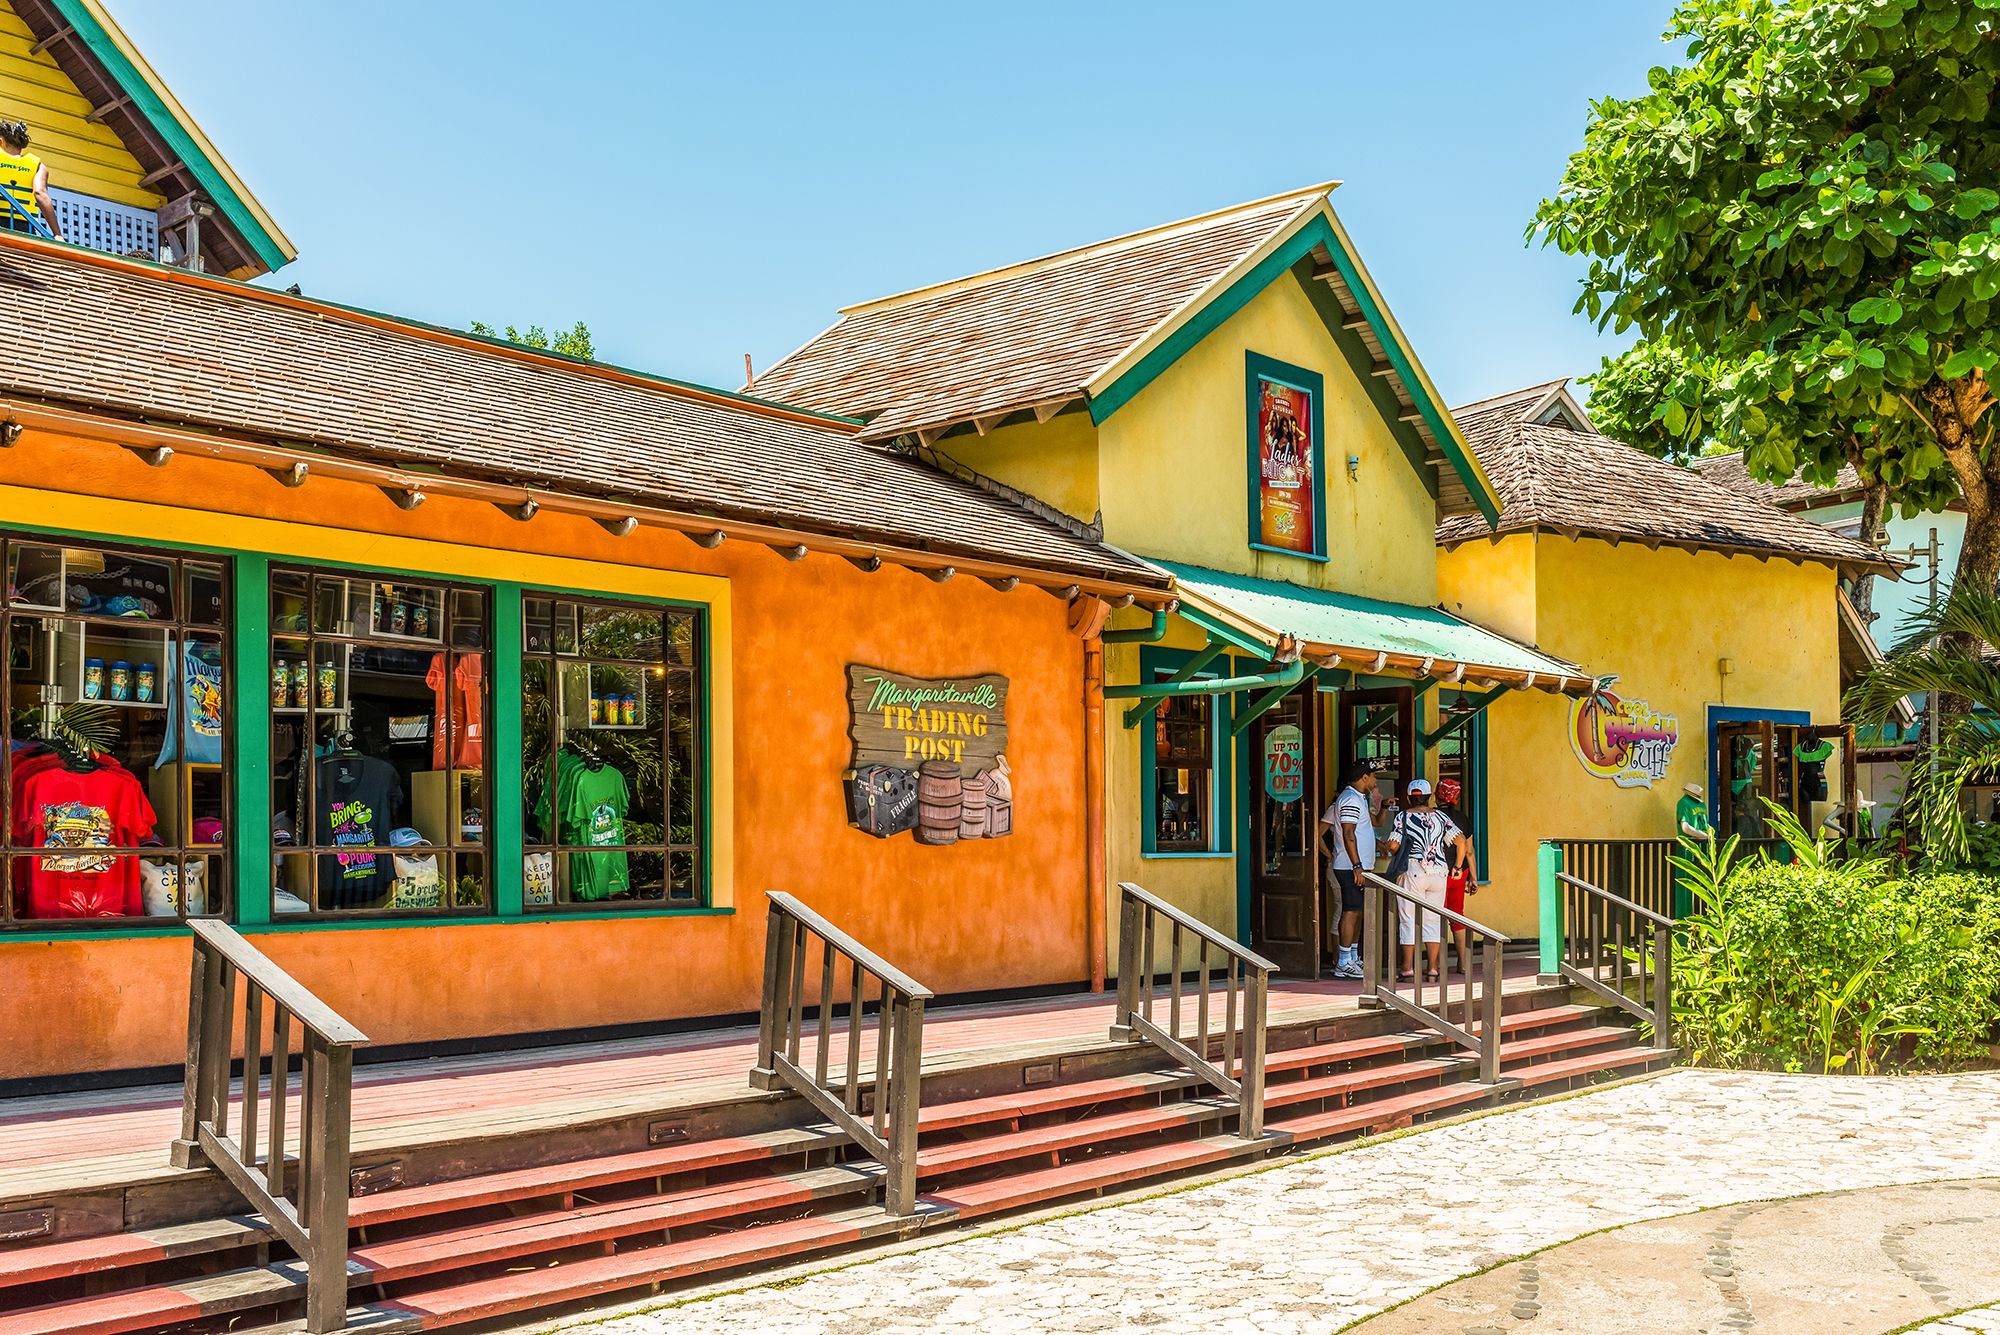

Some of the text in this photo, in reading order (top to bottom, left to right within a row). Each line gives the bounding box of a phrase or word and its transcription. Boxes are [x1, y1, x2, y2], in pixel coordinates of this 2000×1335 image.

[1270, 438, 1302, 467] Ladies
[864, 677, 997, 712] Margaritaville
[1616, 701, 1649, 717] COOL
[880, 705, 988, 737] TRADING
[1604, 715, 1677, 748] BEACH
[904, 735, 965, 763] POST
[1273, 742, 1300, 752] UP TO
[1267, 753, 1303, 774] 70%
[1615, 735, 1671, 777] Stuff
[1272, 775, 1301, 790] OFF
[331, 801, 345, 812] YOU
[890, 788, 918, 819] FRAGILE
[329, 800, 361, 828] BRING
[336, 832, 375, 845] MARGARITAS
[350, 853, 374, 865] POUR
[162, 868, 191, 876] KEP
[527, 862, 550, 873] KEEP
[161, 876, 196, 887] CAM
[526, 871, 553, 882] CALM
[404, 876, 416, 896] 5
[529, 886, 551, 895] SAIL
[534, 894, 549, 903] ON
